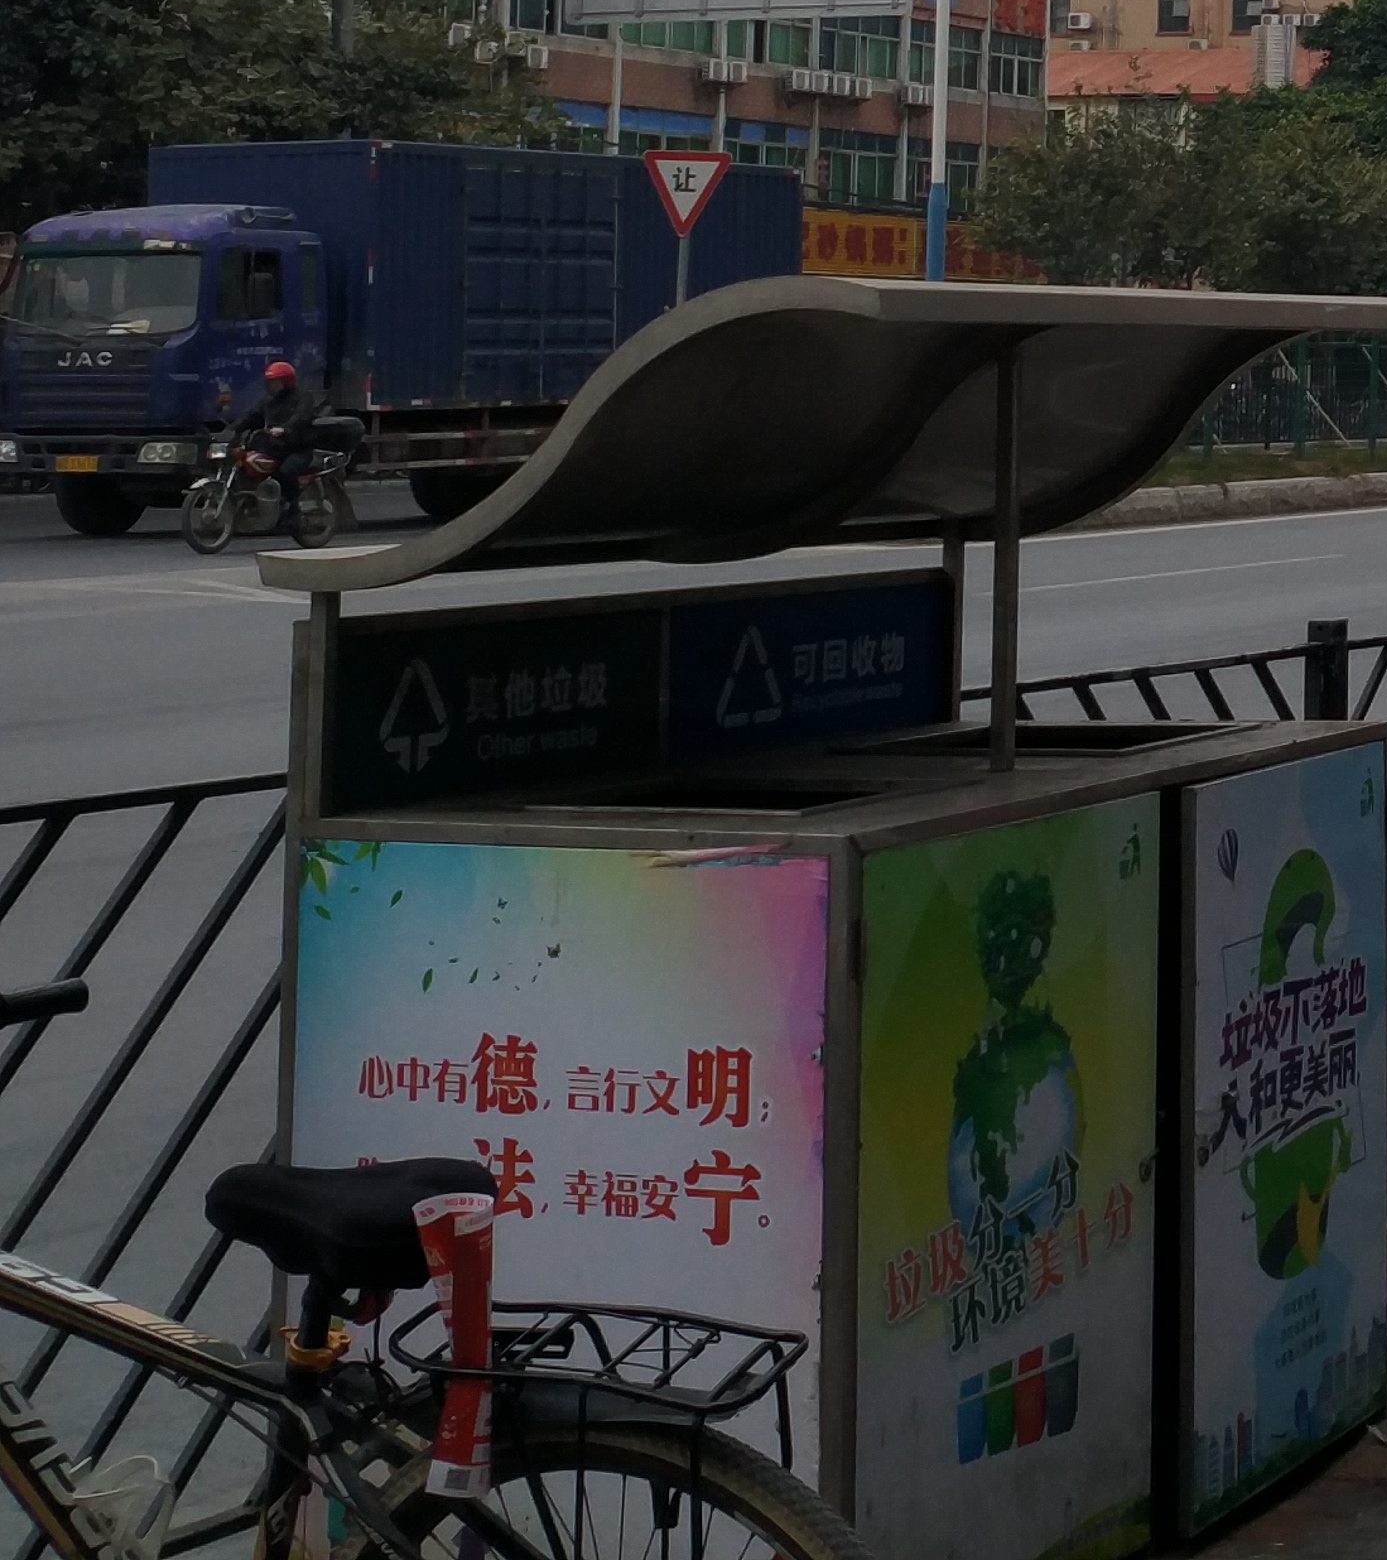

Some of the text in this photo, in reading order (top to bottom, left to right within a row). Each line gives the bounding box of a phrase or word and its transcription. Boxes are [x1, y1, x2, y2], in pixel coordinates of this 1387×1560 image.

[672, 167, 698, 195] 让
[57, 351, 113, 367] JAC
[791, 632, 906, 681] 可回收物
[464, 661, 609, 721] 其他垃圾
[1221, 958, 1366, 1071] 垃圾不落地
[1213, 1029, 1358, 1150] 人和更美丽
